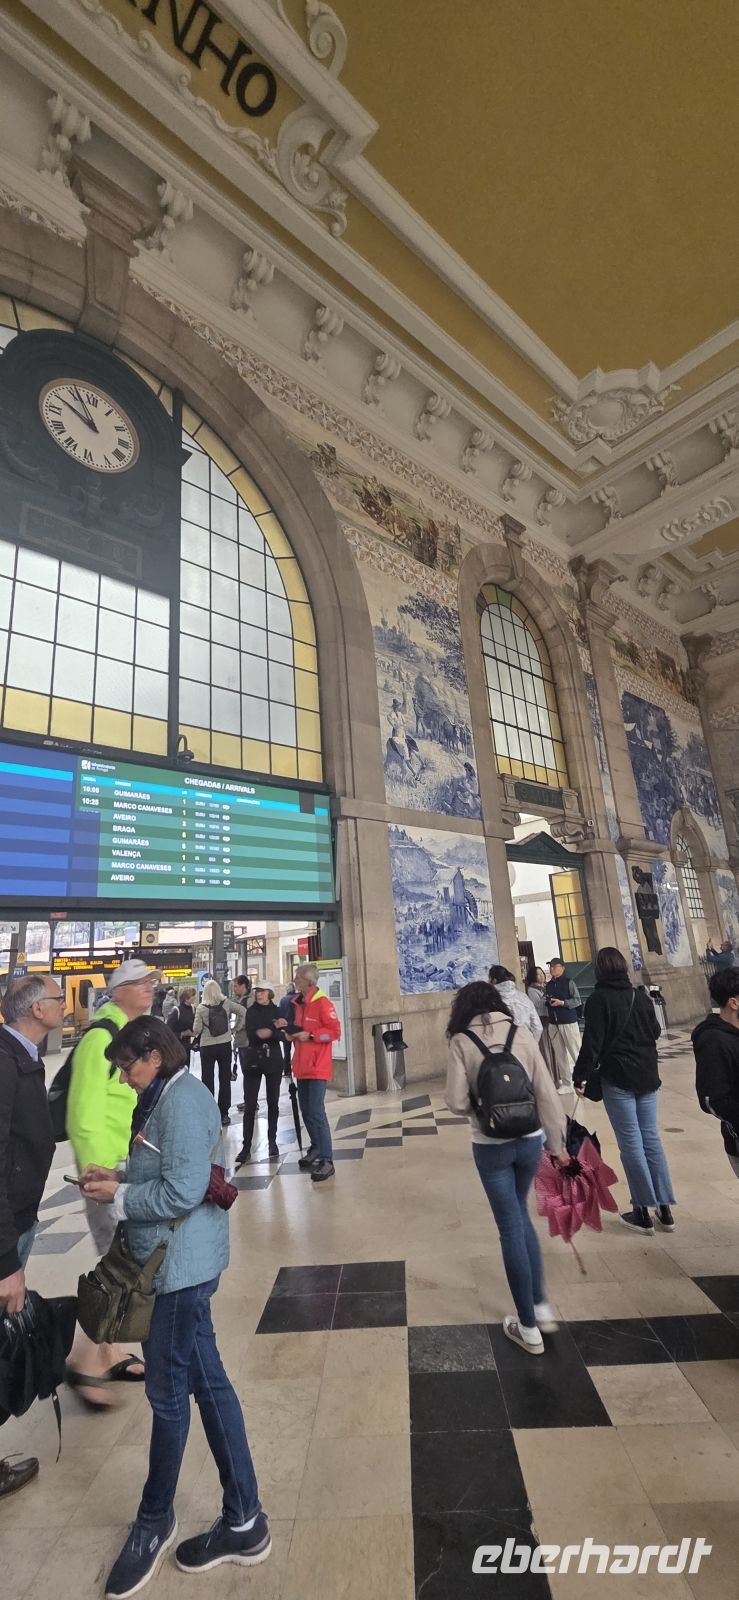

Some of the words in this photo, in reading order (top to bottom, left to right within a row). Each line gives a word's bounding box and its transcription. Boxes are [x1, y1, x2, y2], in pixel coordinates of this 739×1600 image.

[184, 778, 221, 789] CHEGADAS
[225, 784, 256, 794] ARRIVALS
[114, 790, 150, 800] GUIMARÃES
[114, 801, 136, 810] MARCO
[137, 804, 172, 814] CANAVESES
[113, 813, 136, 821] AVEIRO
[112, 825, 135, 833] BRAGA
[112, 837, 149, 846] GUIMARÃES
[112, 849, 141, 858] VALENÇA
